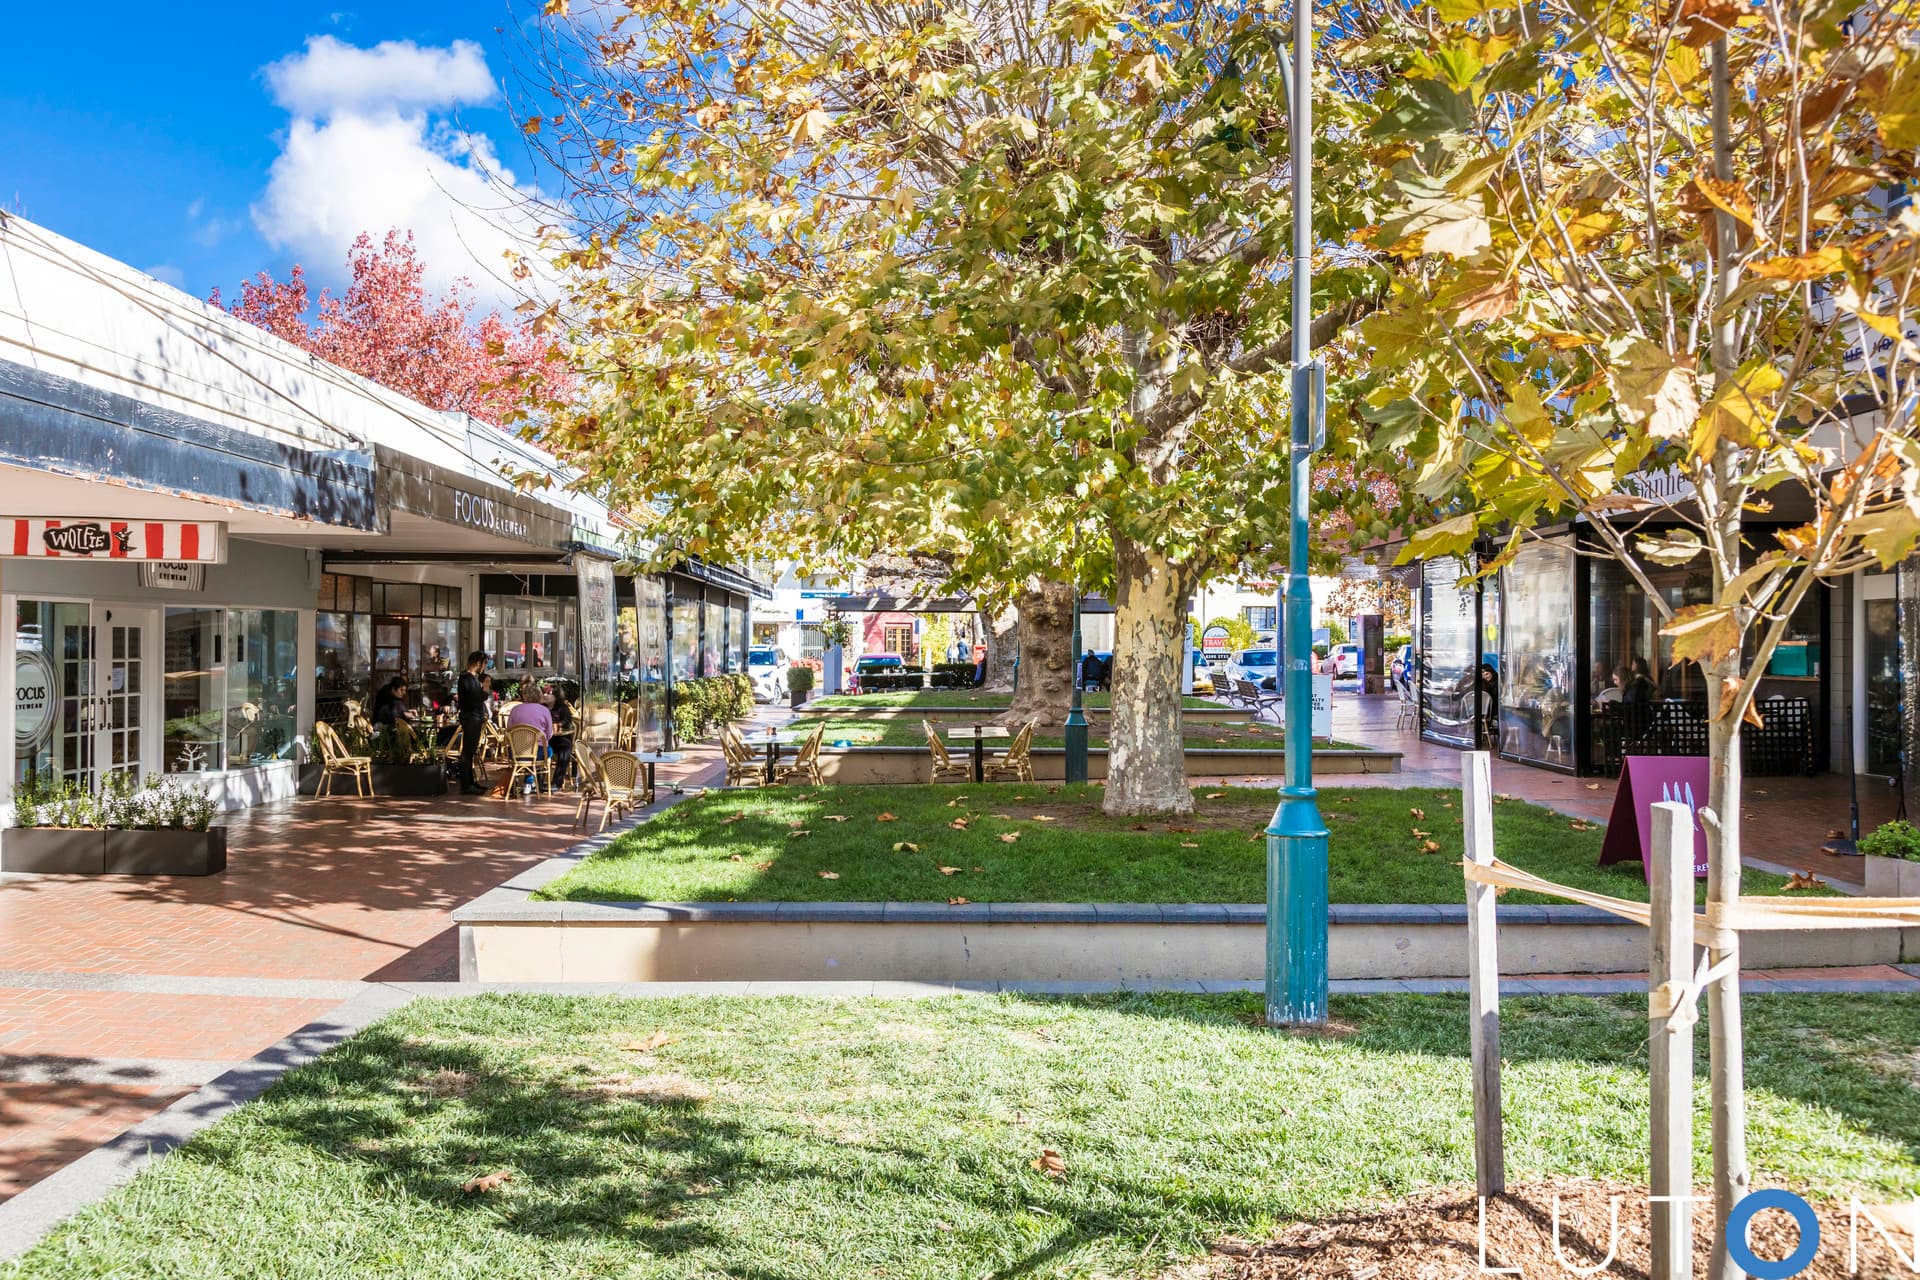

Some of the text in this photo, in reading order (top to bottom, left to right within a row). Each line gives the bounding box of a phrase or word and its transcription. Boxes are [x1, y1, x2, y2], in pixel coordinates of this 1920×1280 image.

[454, 490, 527, 537] FOCUS EYEWEAR
[50, 526, 104, 551] WOLFIE
